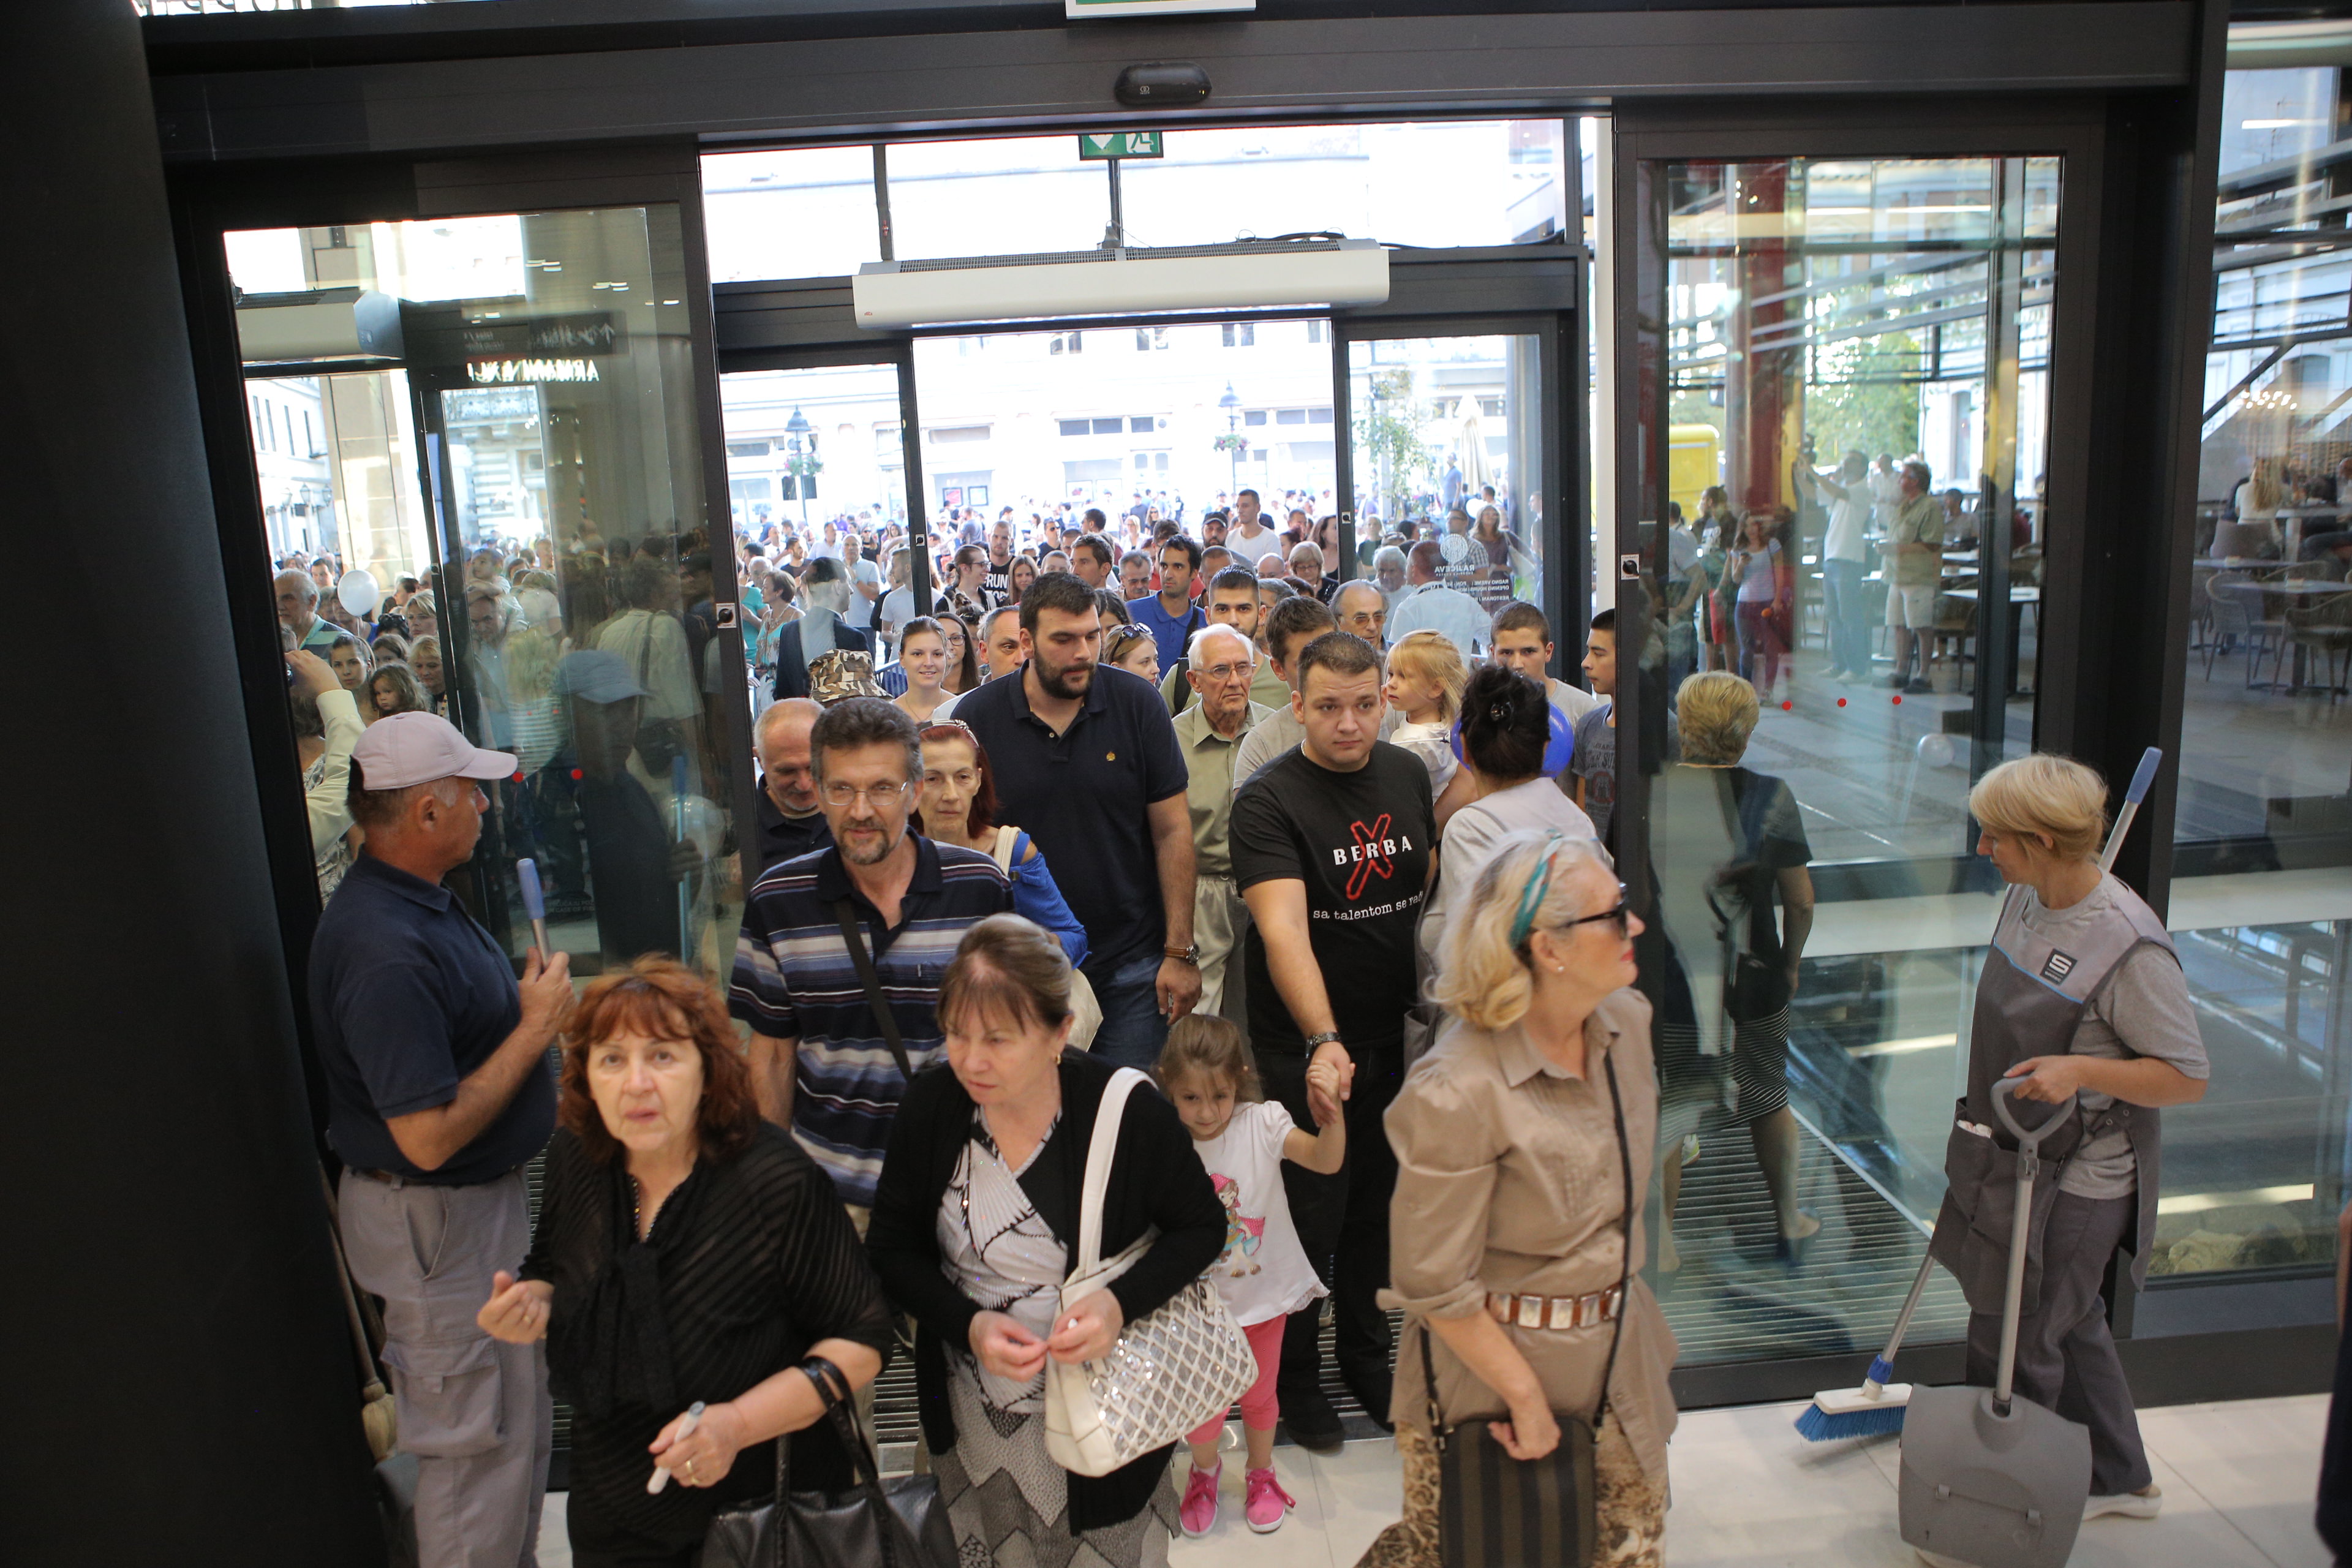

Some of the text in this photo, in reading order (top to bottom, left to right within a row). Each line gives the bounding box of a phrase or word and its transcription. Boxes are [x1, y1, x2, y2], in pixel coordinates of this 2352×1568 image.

[1333, 835, 1412, 865] BERBA
[1313, 910, 1330, 919] sa
[1333, 903, 1393, 921] talentom
[1396, 900, 1407, 911] se
